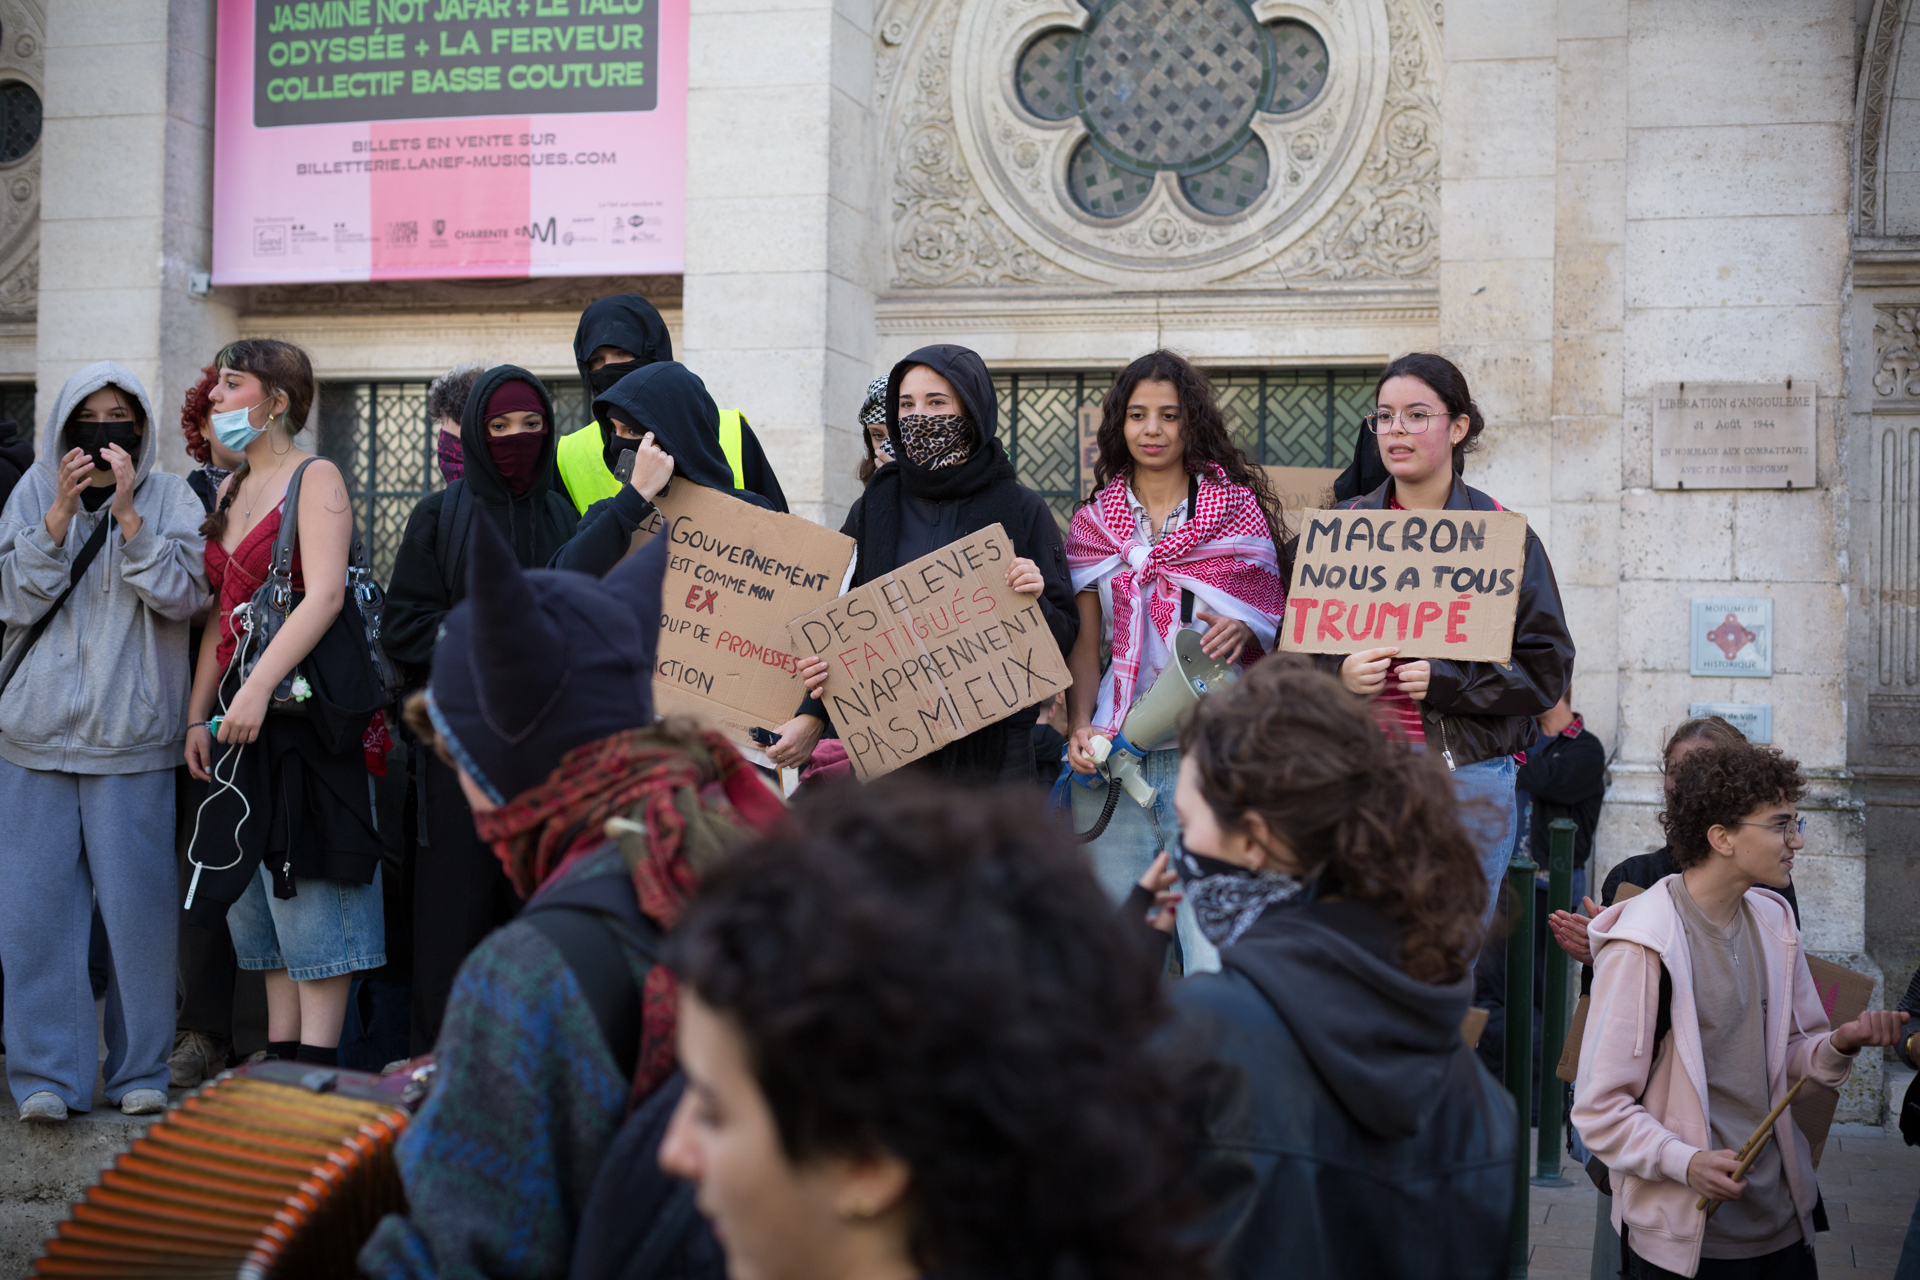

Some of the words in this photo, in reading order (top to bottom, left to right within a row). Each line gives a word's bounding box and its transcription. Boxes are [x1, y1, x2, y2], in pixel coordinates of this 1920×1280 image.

[268, 0, 371, 33] JASMINE
[376, 0, 429, 24] NOT
[434, 0, 511, 21] JAFAR
[535, 0, 569, 17] LE
[268, 26, 406, 68] ODYSSÉE
[414, 39, 430, 58] +
[439, 30, 481, 56] LA
[491, 24, 644, 54] FERVEUR
[266, 70, 406, 103] COLLECTIF
[411, 65, 502, 94] BASSE
[507, 61, 645, 91] COUTURE
[352, 138, 421, 153] BILLETS
[427, 137, 450, 149] EN
[456, 134, 513, 148] VENTE
[519, 133, 556, 147] SUR
[296, 152, 617, 175] BILLETTERIE.LANEF-MUSIQUES.COM
[455, 228, 508, 240] CHARENTE
[1693, 420, 1704, 430] 31
[1716, 418, 1742, 430] Août
[1753, 419, 1775, 430] 1944
[1660, 447, 1671, 457] EN
[1674, 447, 1719, 457] HOMMAGE
[1722, 447, 1741, 456] AUX
[1744, 446, 1809, 456] COMBATTANTS
[1681, 465, 1703, 475] AVEC
[1705, 465, 1717, 474] ET
[1720, 465, 1742, 475] SANS
[1745, 464, 1789, 474] UNIFORME
[1306, 516, 1487, 554] MACRON
[671, 516, 830, 592] GOUVERNEMENT
[667, 551, 695, 573] EST
[694, 563, 746, 595] COMME
[748, 583, 775, 601] MON
[1300, 563, 1387, 593] NOUS
[1394, 566, 1420, 592] A
[1432, 565, 1515, 596] TOUS
[685, 585, 719, 614] EX
[801, 598, 877, 654] DES
[881, 539, 1001, 614] ELEVES
[693, 624, 711, 644] DE
[838, 587, 997, 679] FATIGUÉS
[1289, 593, 1474, 645] TRUMPÉ
[832, 606, 1039, 725] N'APPRENNENT
[1703, 660, 1758, 669] HISTORIQUE
[848, 716, 919, 777] PAS
[917, 647, 1057, 744] MIEUX
[1728, 712, 1738, 720] de
